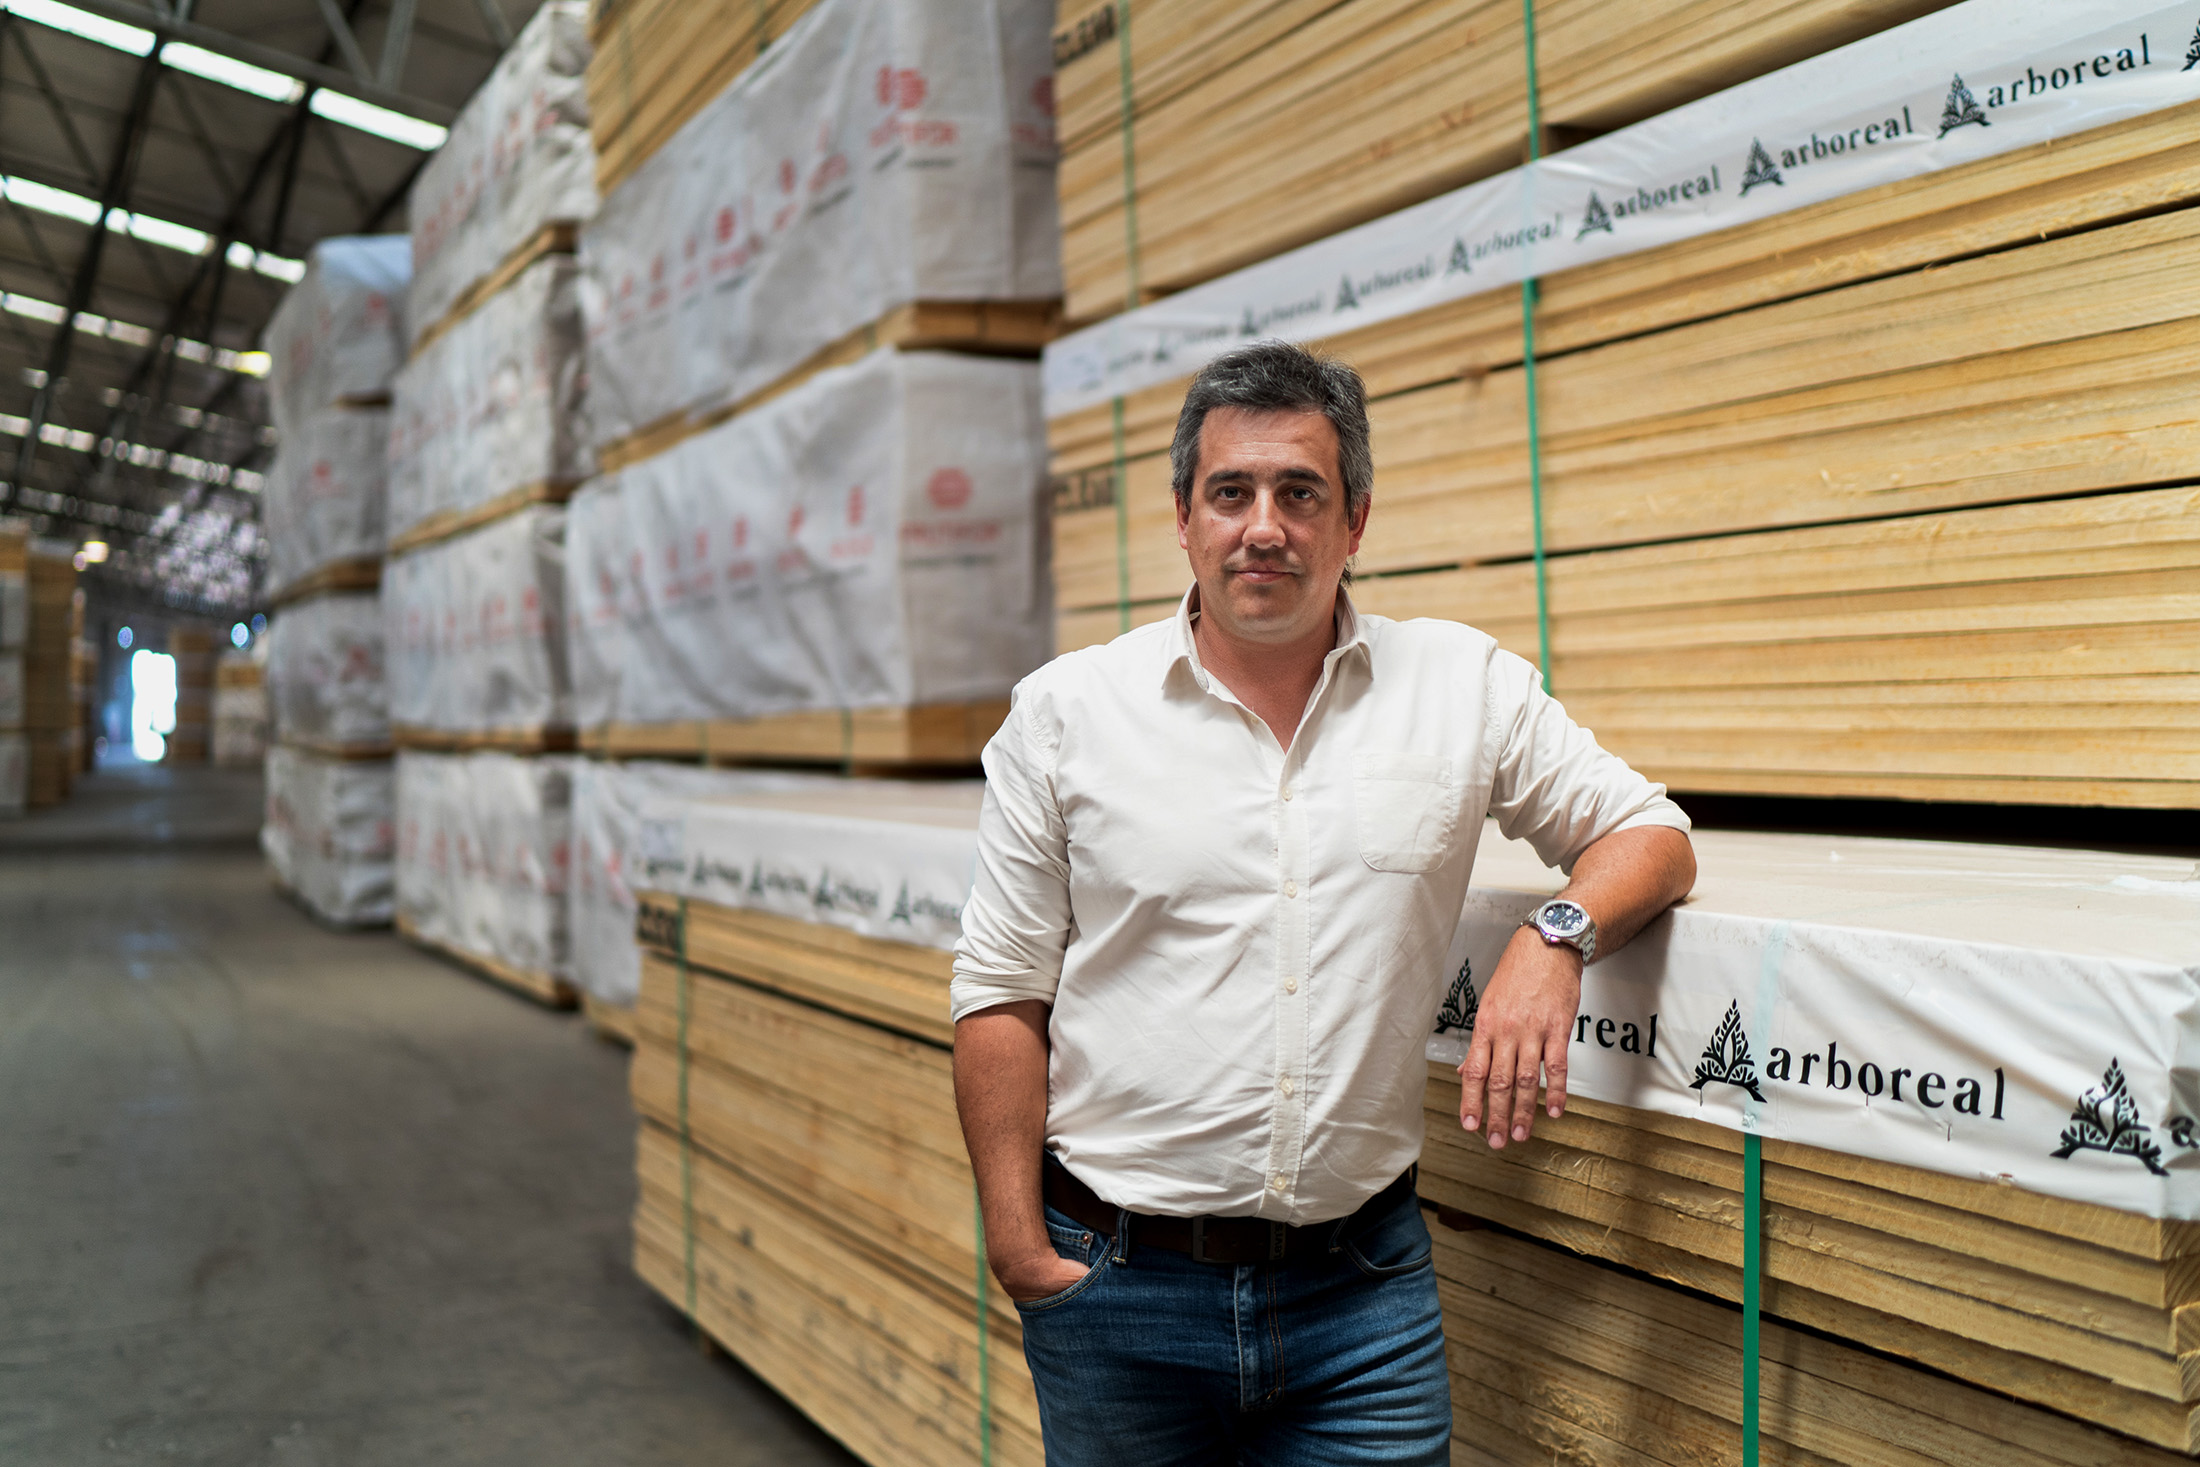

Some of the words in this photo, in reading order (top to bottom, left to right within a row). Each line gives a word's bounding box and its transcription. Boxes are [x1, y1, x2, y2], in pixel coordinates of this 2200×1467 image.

[1613, 164, 1721, 219] arboreal
[1781, 104, 1913, 169] arboreal
[1987, 32, 2152, 109] arboreal
[1575, 1012, 1658, 1059] real
[1766, 1041, 2005, 1120] arboreal
